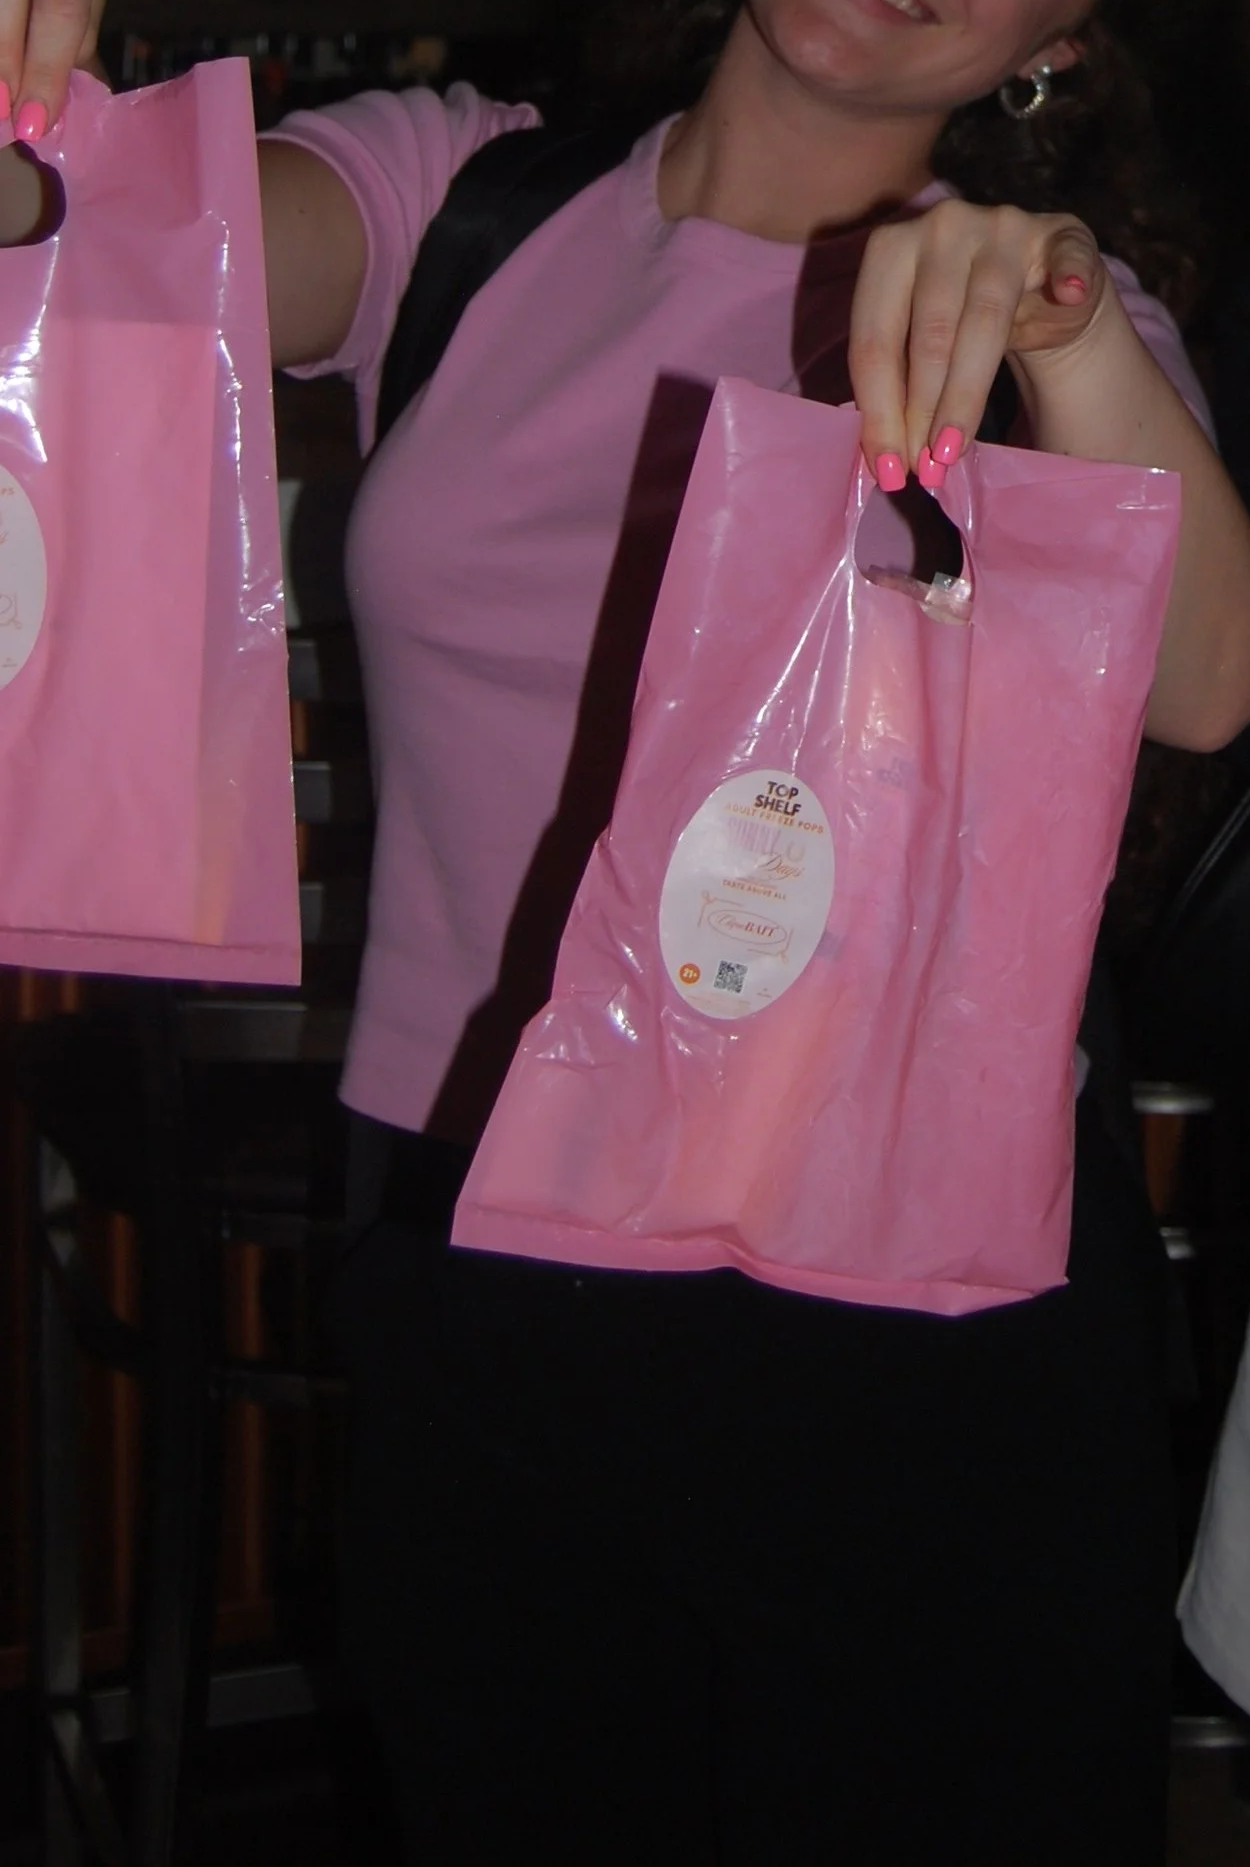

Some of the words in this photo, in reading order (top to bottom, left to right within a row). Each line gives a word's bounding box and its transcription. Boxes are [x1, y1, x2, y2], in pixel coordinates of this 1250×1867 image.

[768, 781, 800, 800] TOP
[754, 794, 802, 817] SHELF
[725, 802, 757, 816] ADULT
[797, 820, 825, 834] POPS
